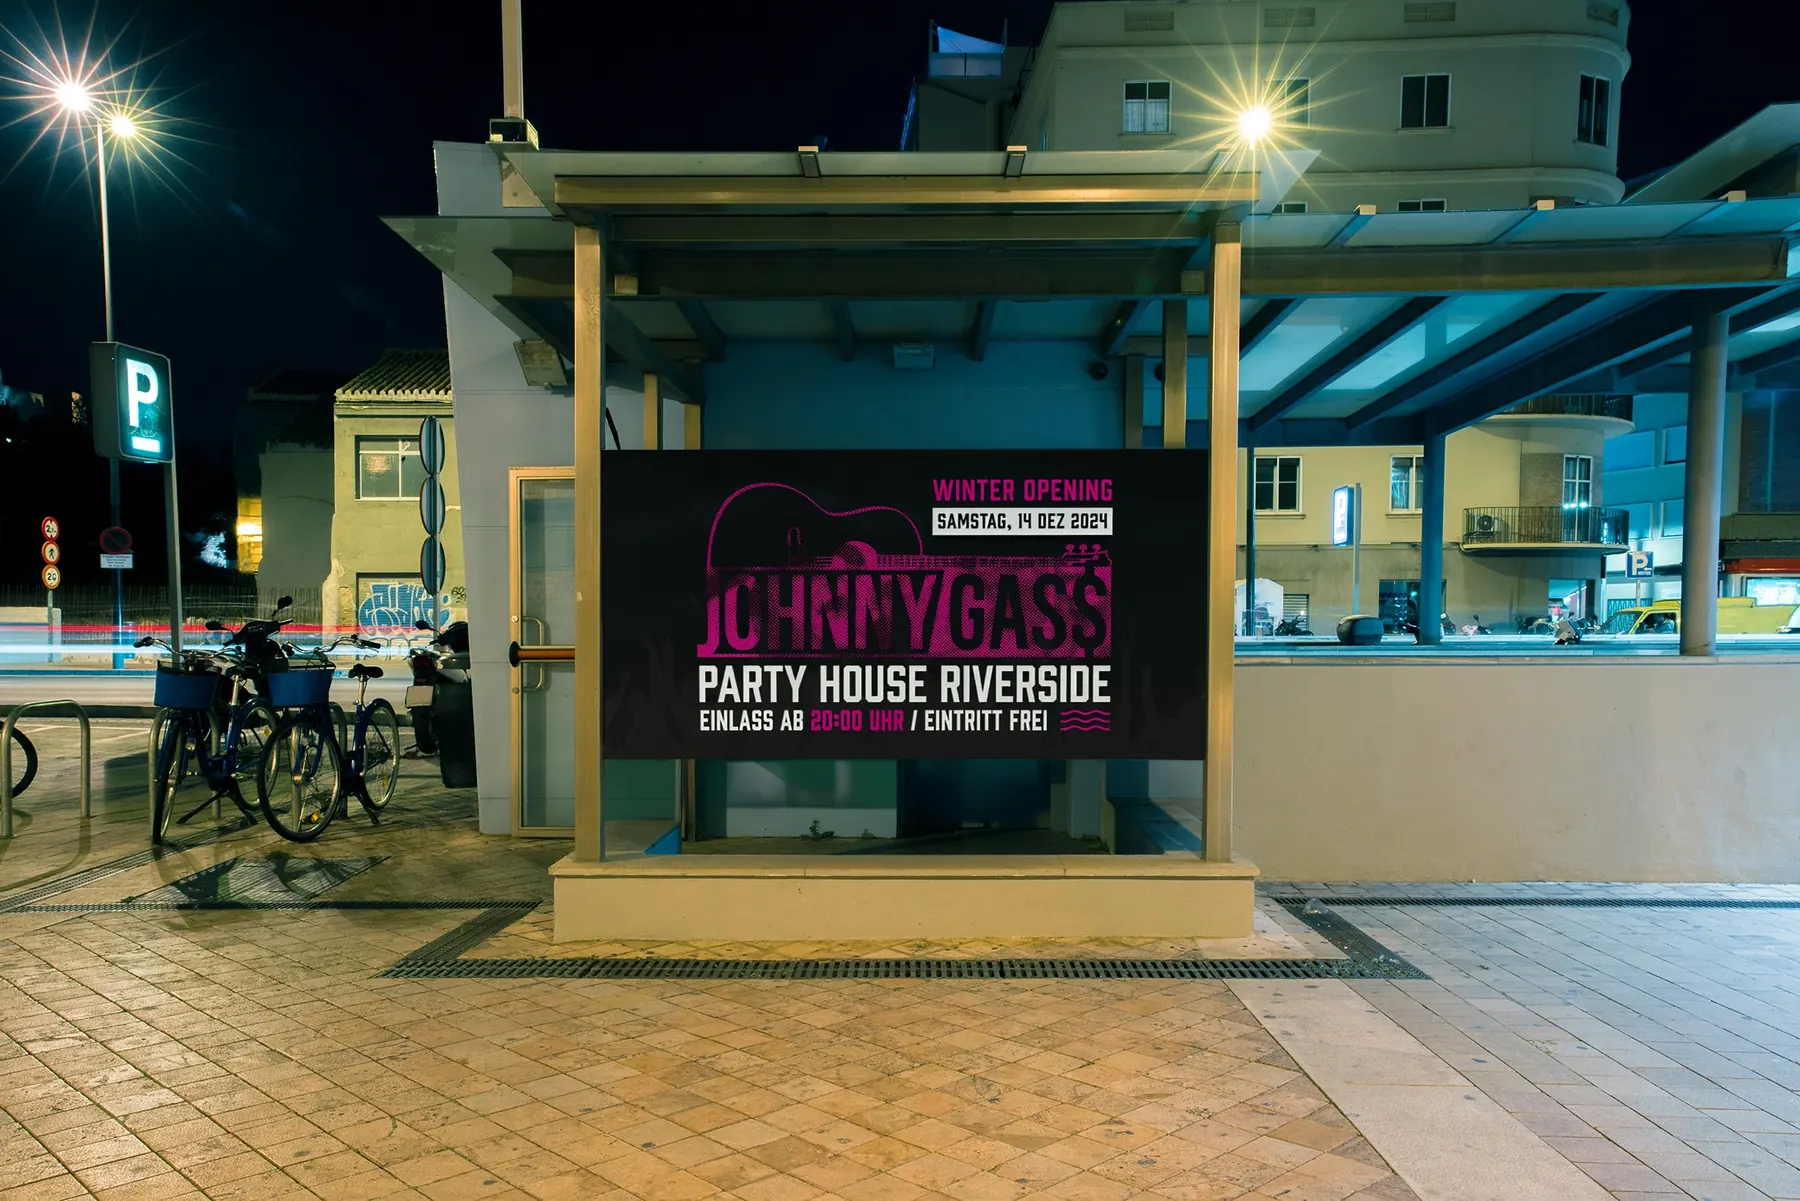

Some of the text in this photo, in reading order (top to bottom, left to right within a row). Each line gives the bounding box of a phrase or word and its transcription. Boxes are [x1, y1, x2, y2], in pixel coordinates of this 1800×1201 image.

[126, 358, 159, 428] P
[933, 479, 1113, 502] WINTER OPENING
[937, 512, 1108, 531] SAMSTAG, 14 DEZ 2024
[1632, 553, 1648, 575] P
[698, 665, 1112, 703] PARTY HOUSE RIVERSIDE
[699, 709, 1048, 732] EINLASS AB 20:00 UHR / EINTRITT FREI
